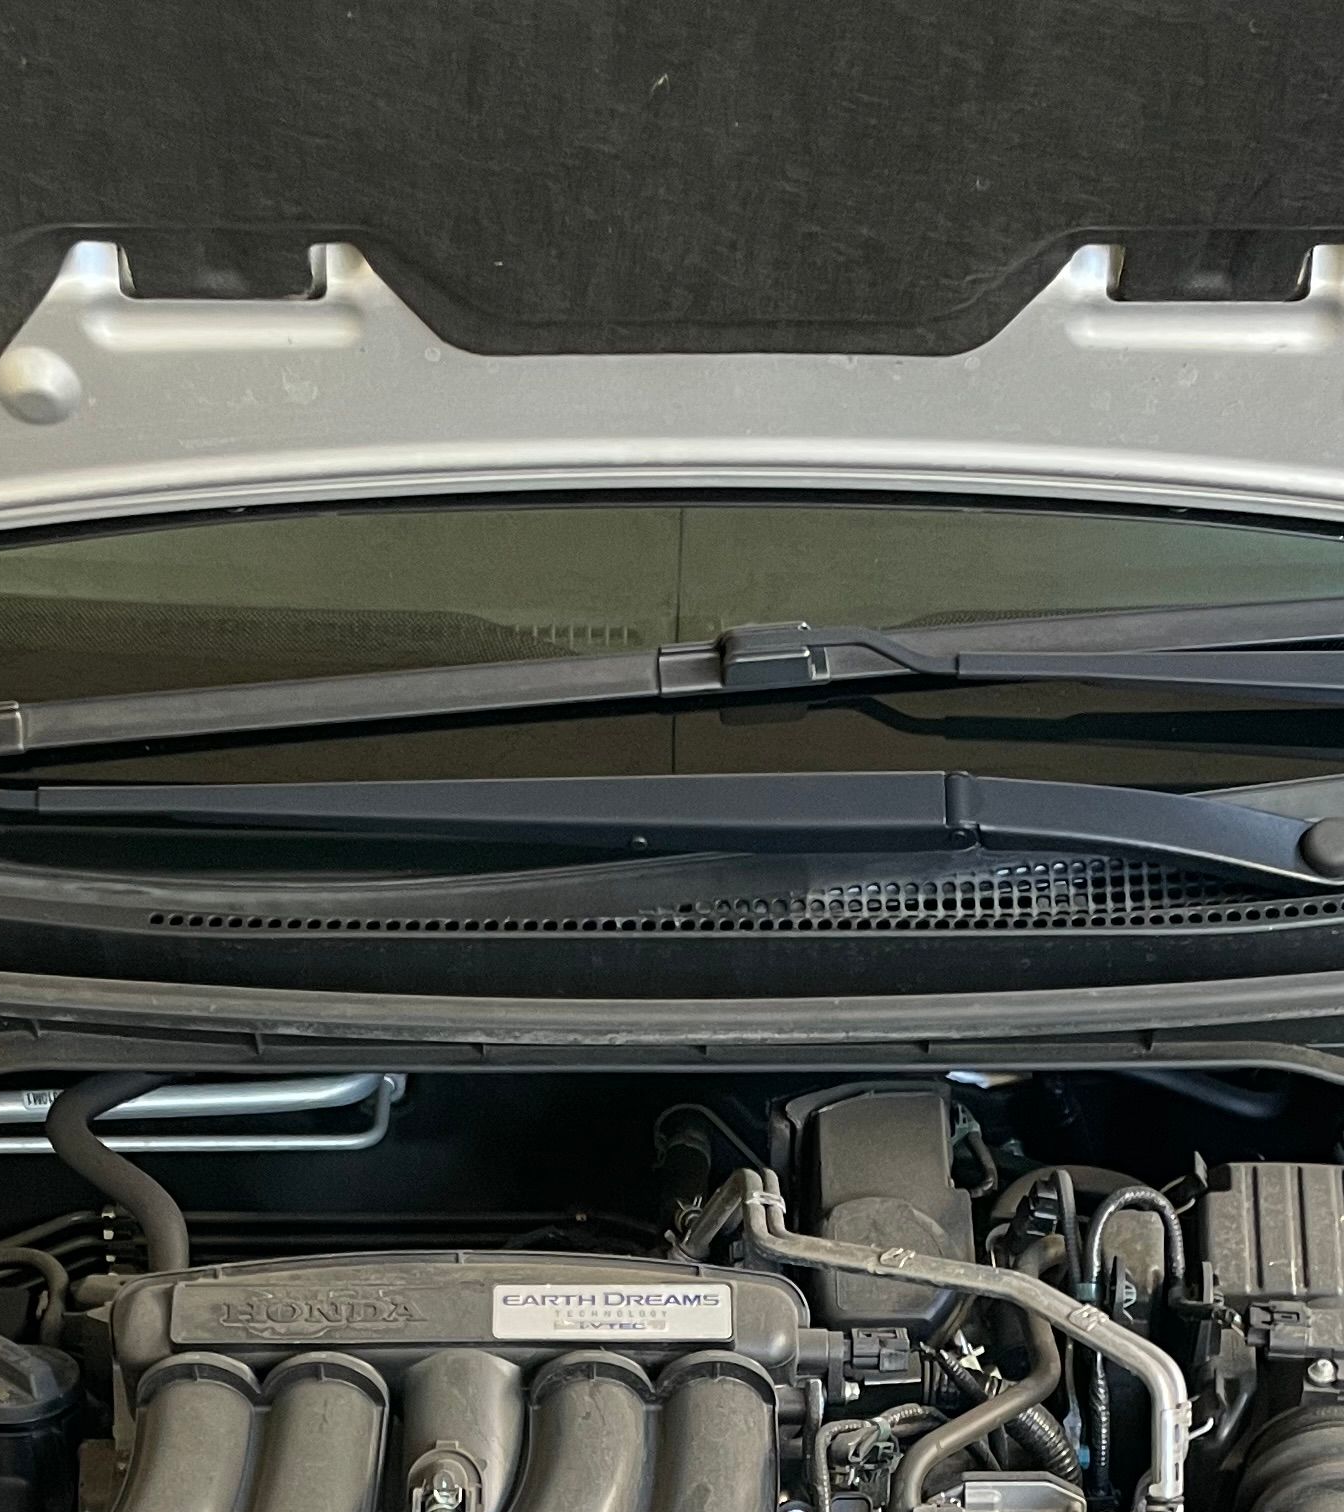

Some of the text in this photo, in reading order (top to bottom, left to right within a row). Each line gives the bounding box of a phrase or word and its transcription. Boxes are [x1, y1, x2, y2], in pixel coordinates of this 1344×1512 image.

[502, 1292, 719, 1307] EARTH DREAMS
[221, 1301, 428, 1323] HONDA
[555, 1310, 668, 1318] TECHNOLOGY
